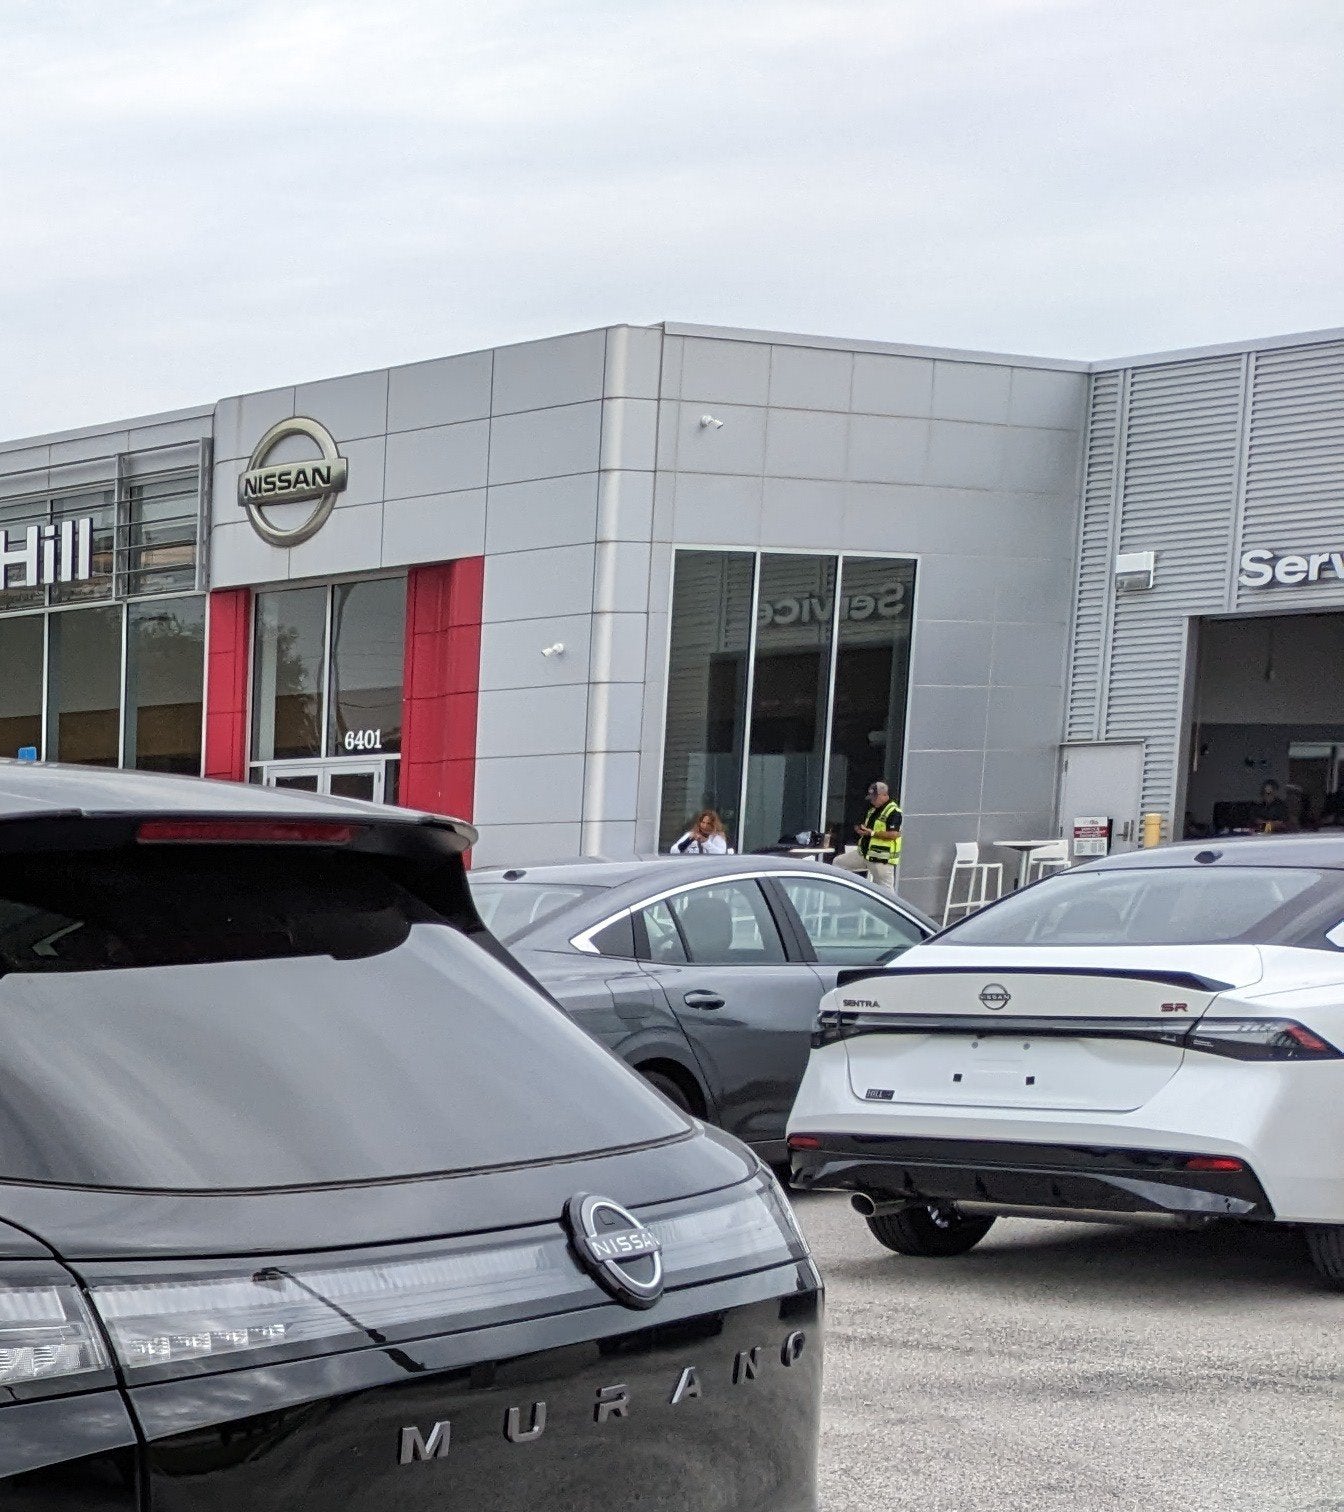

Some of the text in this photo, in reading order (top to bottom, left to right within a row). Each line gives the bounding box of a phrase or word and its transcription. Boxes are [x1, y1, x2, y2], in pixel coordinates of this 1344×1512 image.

[243, 465, 332, 498] NISSAN
[344, 728, 382, 750] 6401
[842, 999, 881, 1008] SENTRA
[1160, 1002, 1189, 1013] SR
[590, 1232, 662, 1257] NISSAN
[398, 1330, 806, 1466] MURANO
